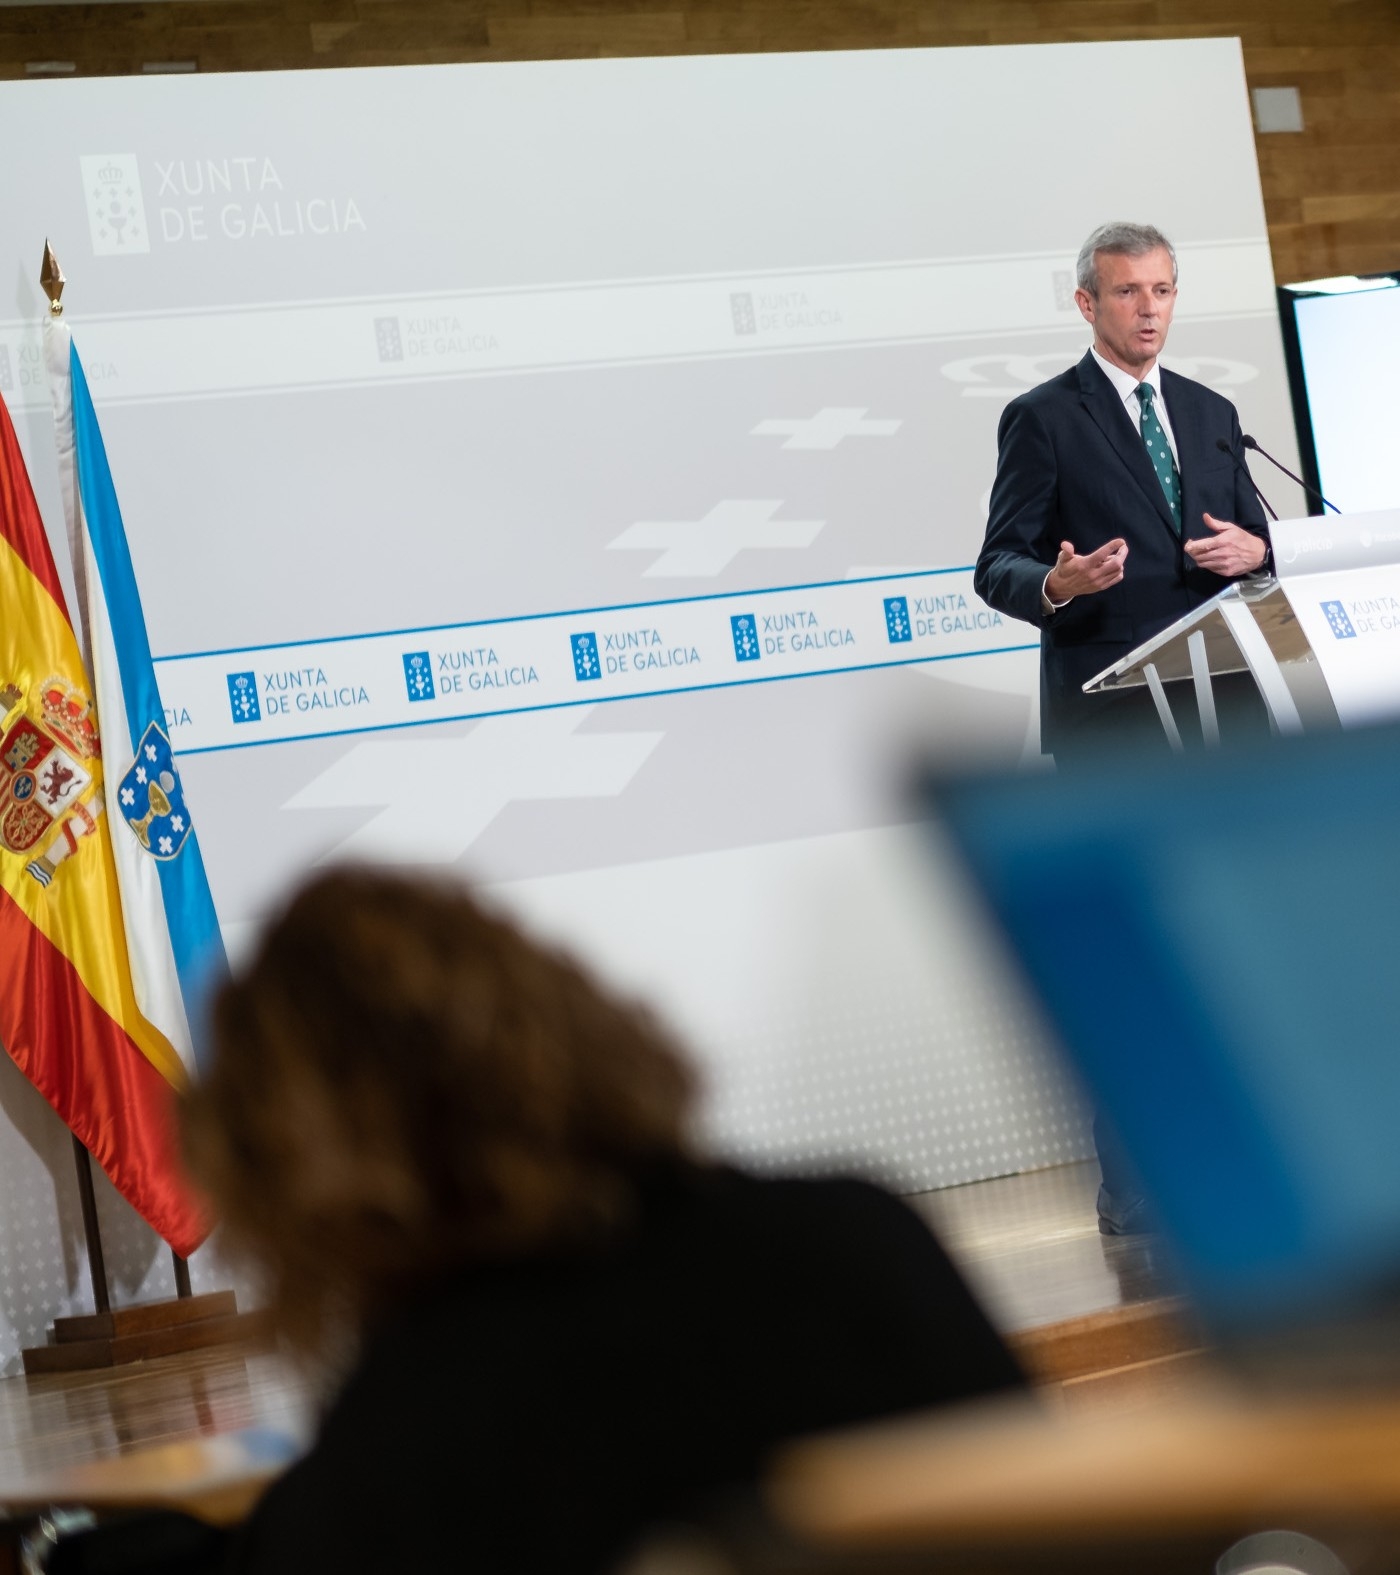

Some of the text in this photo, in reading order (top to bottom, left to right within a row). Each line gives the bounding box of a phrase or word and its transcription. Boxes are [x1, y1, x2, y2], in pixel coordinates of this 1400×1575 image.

[153, 155, 283, 197] XUNTA
[159, 198, 367, 242] DE GALICIA
[759, 291, 811, 310] XUNTA
[406, 315, 463, 336] XUNTA
[760, 307, 843, 330] DE GALICIA
[407, 333, 500, 357] DE GALICIA
[19, 367, 42, 386] DE
[914, 594, 968, 615] XUNTA
[1348, 597, 1400, 615] XUNTA
[762, 611, 819, 633] XUNTA
[916, 612, 1004, 637] DE GALICIA
[1356, 617, 1377, 633] DE
[603, 629, 663, 652] XUNTA
[764, 629, 856, 655] DE GALICIA
[437, 648, 499, 672] XUNTA
[606, 647, 701, 674] DE GALICIA
[263, 667, 328, 693] XUNTA
[440, 666, 540, 695] DE GALICIA
[265, 685, 370, 716] DE GALICIA
